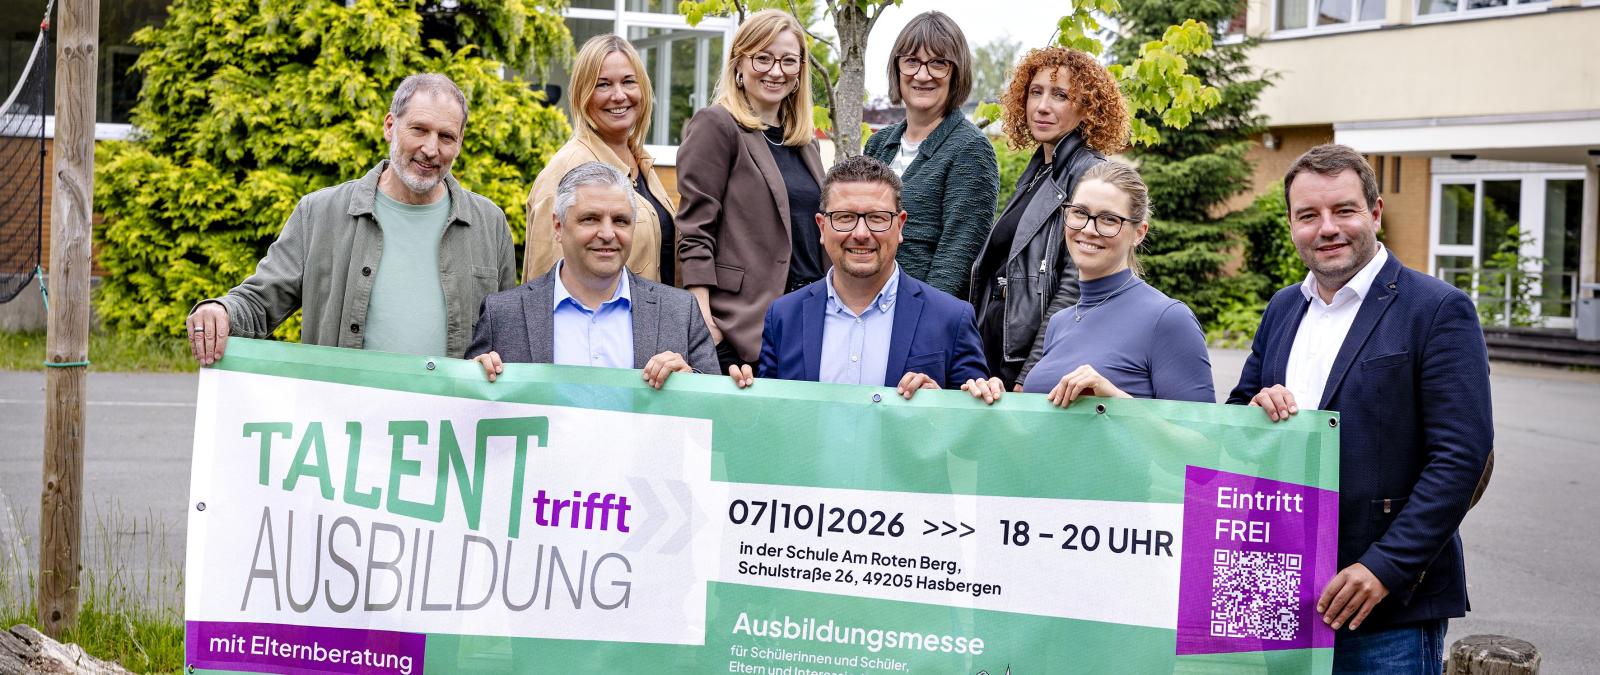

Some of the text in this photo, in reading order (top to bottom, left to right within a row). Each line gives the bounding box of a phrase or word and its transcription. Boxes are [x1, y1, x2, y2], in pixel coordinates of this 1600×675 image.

[243, 415, 550, 540] TALENT
[532, 489, 633, 533] trifft
[1216, 486, 1304, 513] Eintritt
[728, 499, 905, 537] 07|10|2026
[999, 520, 1030, 547] 18
[1061, 525, 1101, 551] 20
[1107, 526, 1174, 557] UHR
[1214, 518, 1271, 544] FREI
[240, 506, 633, 614] AUSBILDUNG
[739, 541, 961, 575] in der Schule Am Roten Berg,
[738, 561, 1002, 597] Schulstraße 26, 49205 Hasbergen
[732, 612, 985, 655] Ausbildungsmesse
[209, 634, 413, 675] mit Elternberatung
[729, 661, 766, 675] Eltern
[767, 666, 792, 675] und
[730, 644, 749, 657] für
[750, 646, 832, 665] Schülerinnen
[834, 655, 858, 667] und
[860, 656, 910, 673] Schüler,
